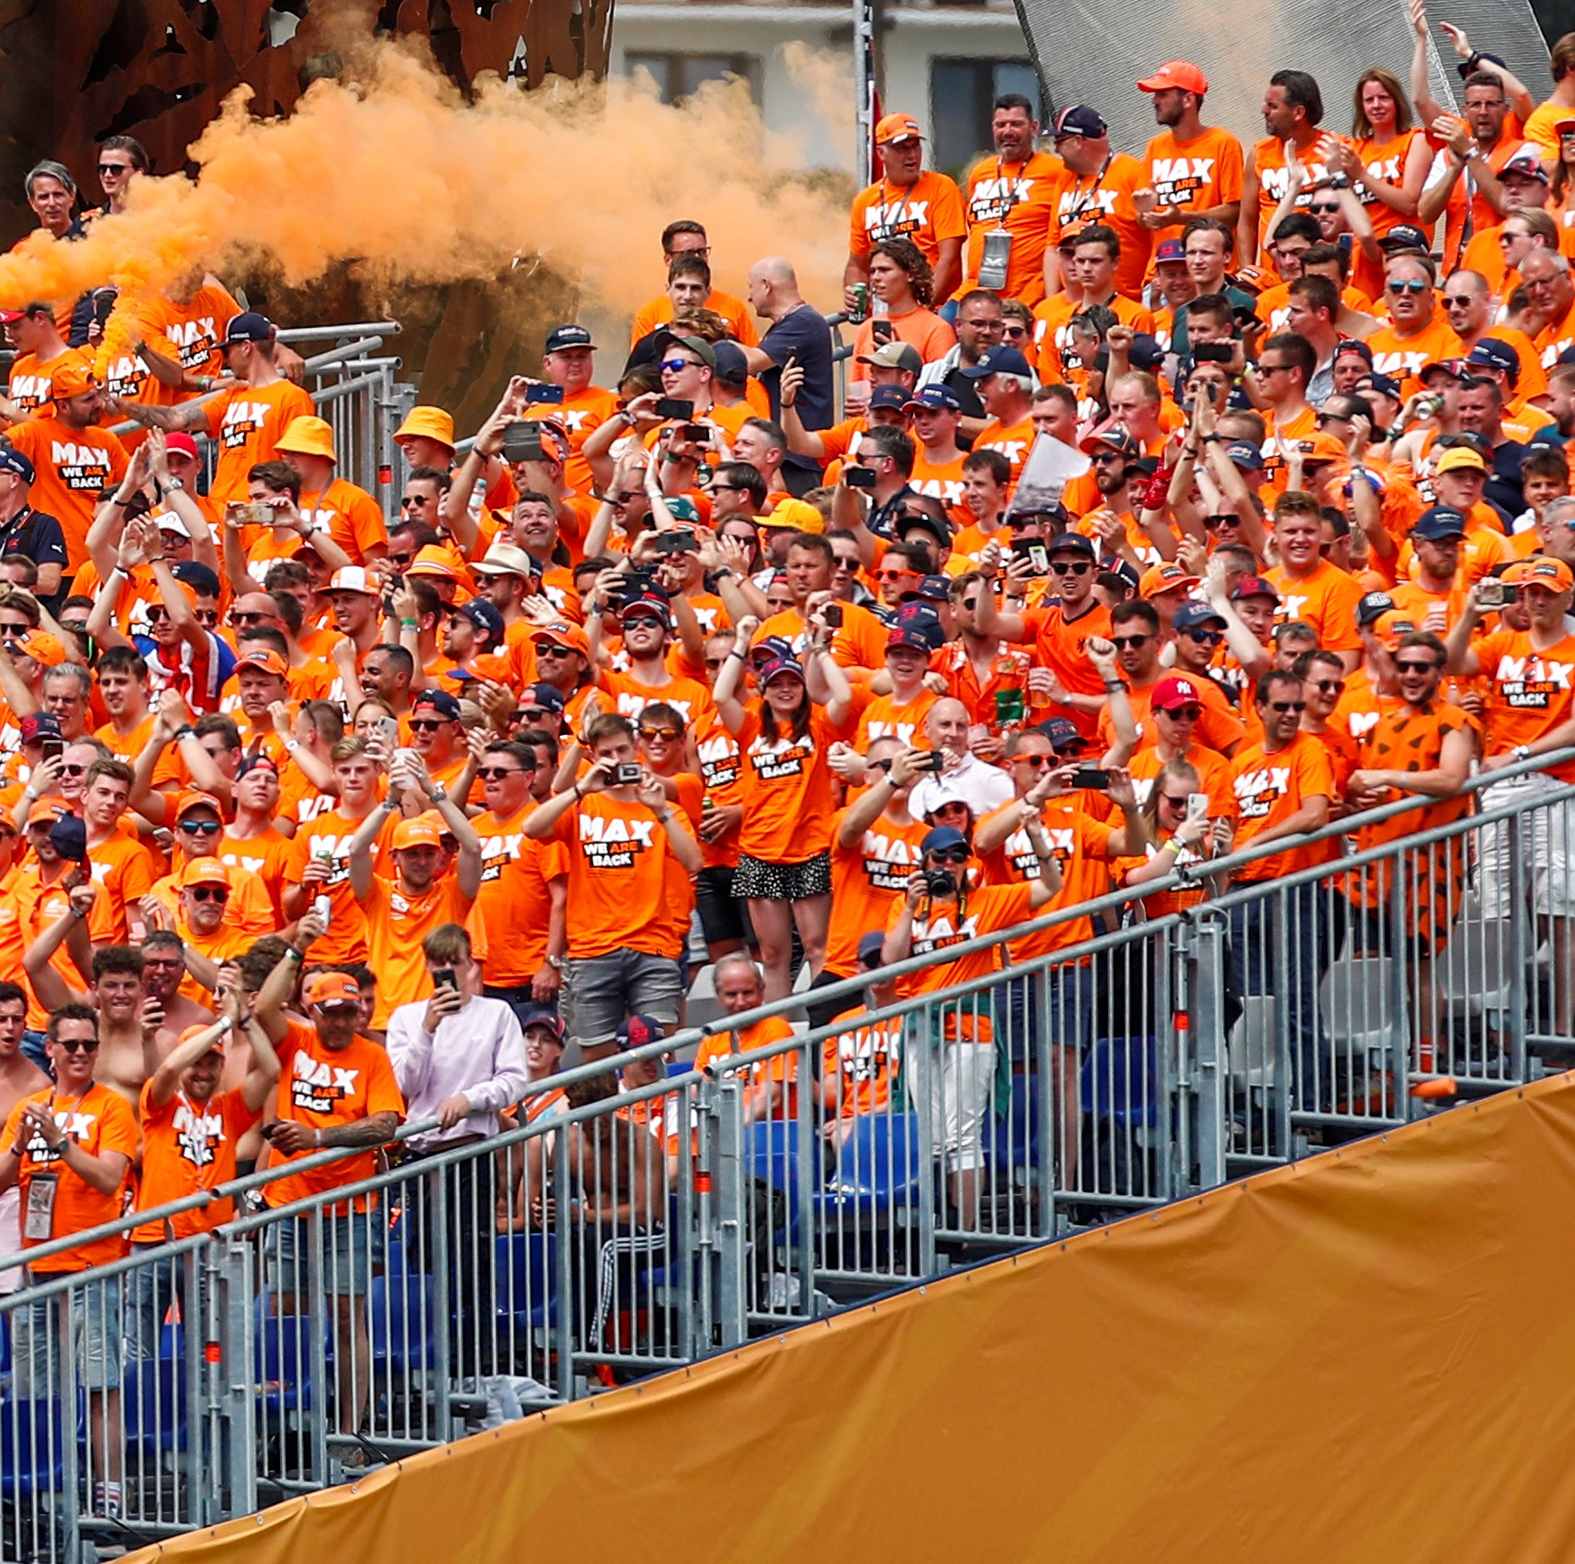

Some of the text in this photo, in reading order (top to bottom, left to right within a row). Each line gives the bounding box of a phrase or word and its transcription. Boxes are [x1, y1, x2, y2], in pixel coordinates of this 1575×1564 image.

[1152, 158, 1215, 183] MAX
[225, 402, 271, 426] MAX
[62, 466, 104, 477] WE ARE
[71, 477, 103, 487] BACK
[1504, 681, 1556, 694] WE ARE
[1509, 693, 1546, 706] BACK
[762, 763, 801, 777] BACK
[580, 814, 653, 846] MAX
[585, 840, 639, 854] WE ARE
[593, 853, 631, 866] BACK
[294, 1049, 359, 1093] MAX
